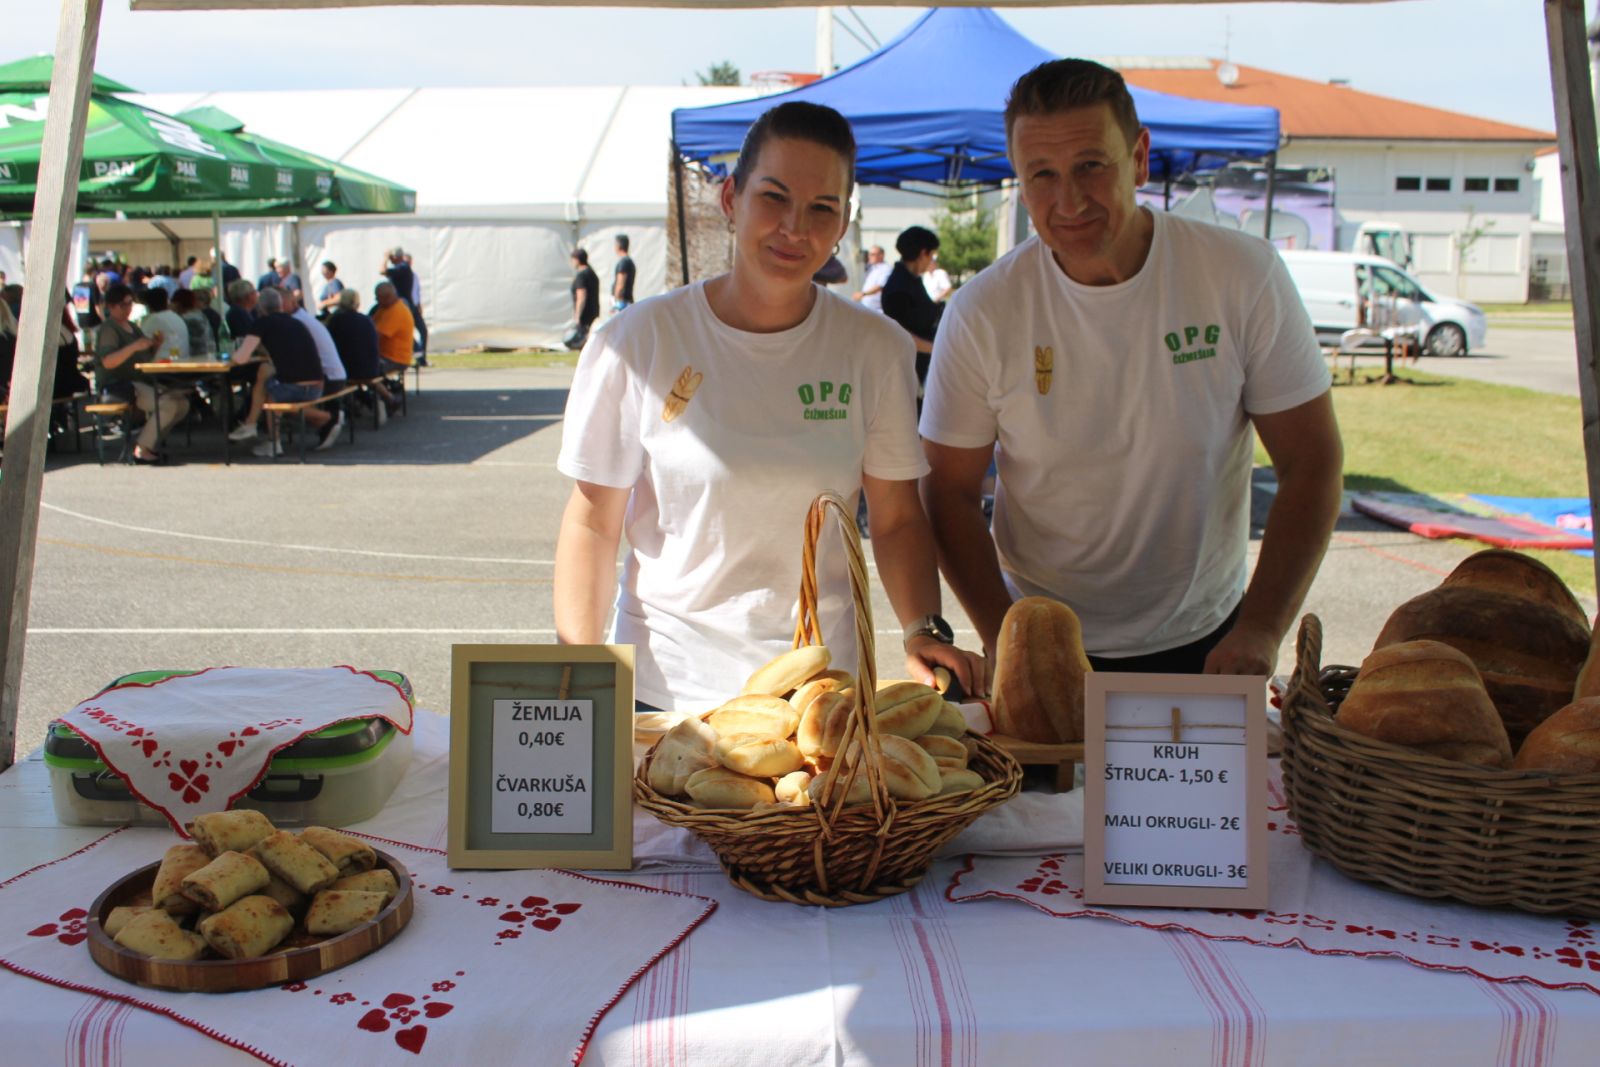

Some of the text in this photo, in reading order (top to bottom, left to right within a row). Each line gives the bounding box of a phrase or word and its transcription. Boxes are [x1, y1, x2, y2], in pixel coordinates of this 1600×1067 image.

[94, 161, 136, 177] PAN
[176, 160, 197, 177] PAN
[230, 167, 249, 183] PAN
[277, 172, 293, 185] PAN
[511, 701, 582, 721] ŽEMLJA
[518, 731, 565, 749] 0,40€
[1153, 745, 1199, 760] KRUH
[1104, 763, 1228, 785] ŠTRUCA- 1,50 €
[496, 774, 586, 793] ČVARKUŠA
[517, 802, 564, 819] 0,80€
[1104, 814, 1240, 831] MALI OKRUGLI- 2€
[1104, 862, 1248, 879] VELIKI OKRUGLI- 3€
